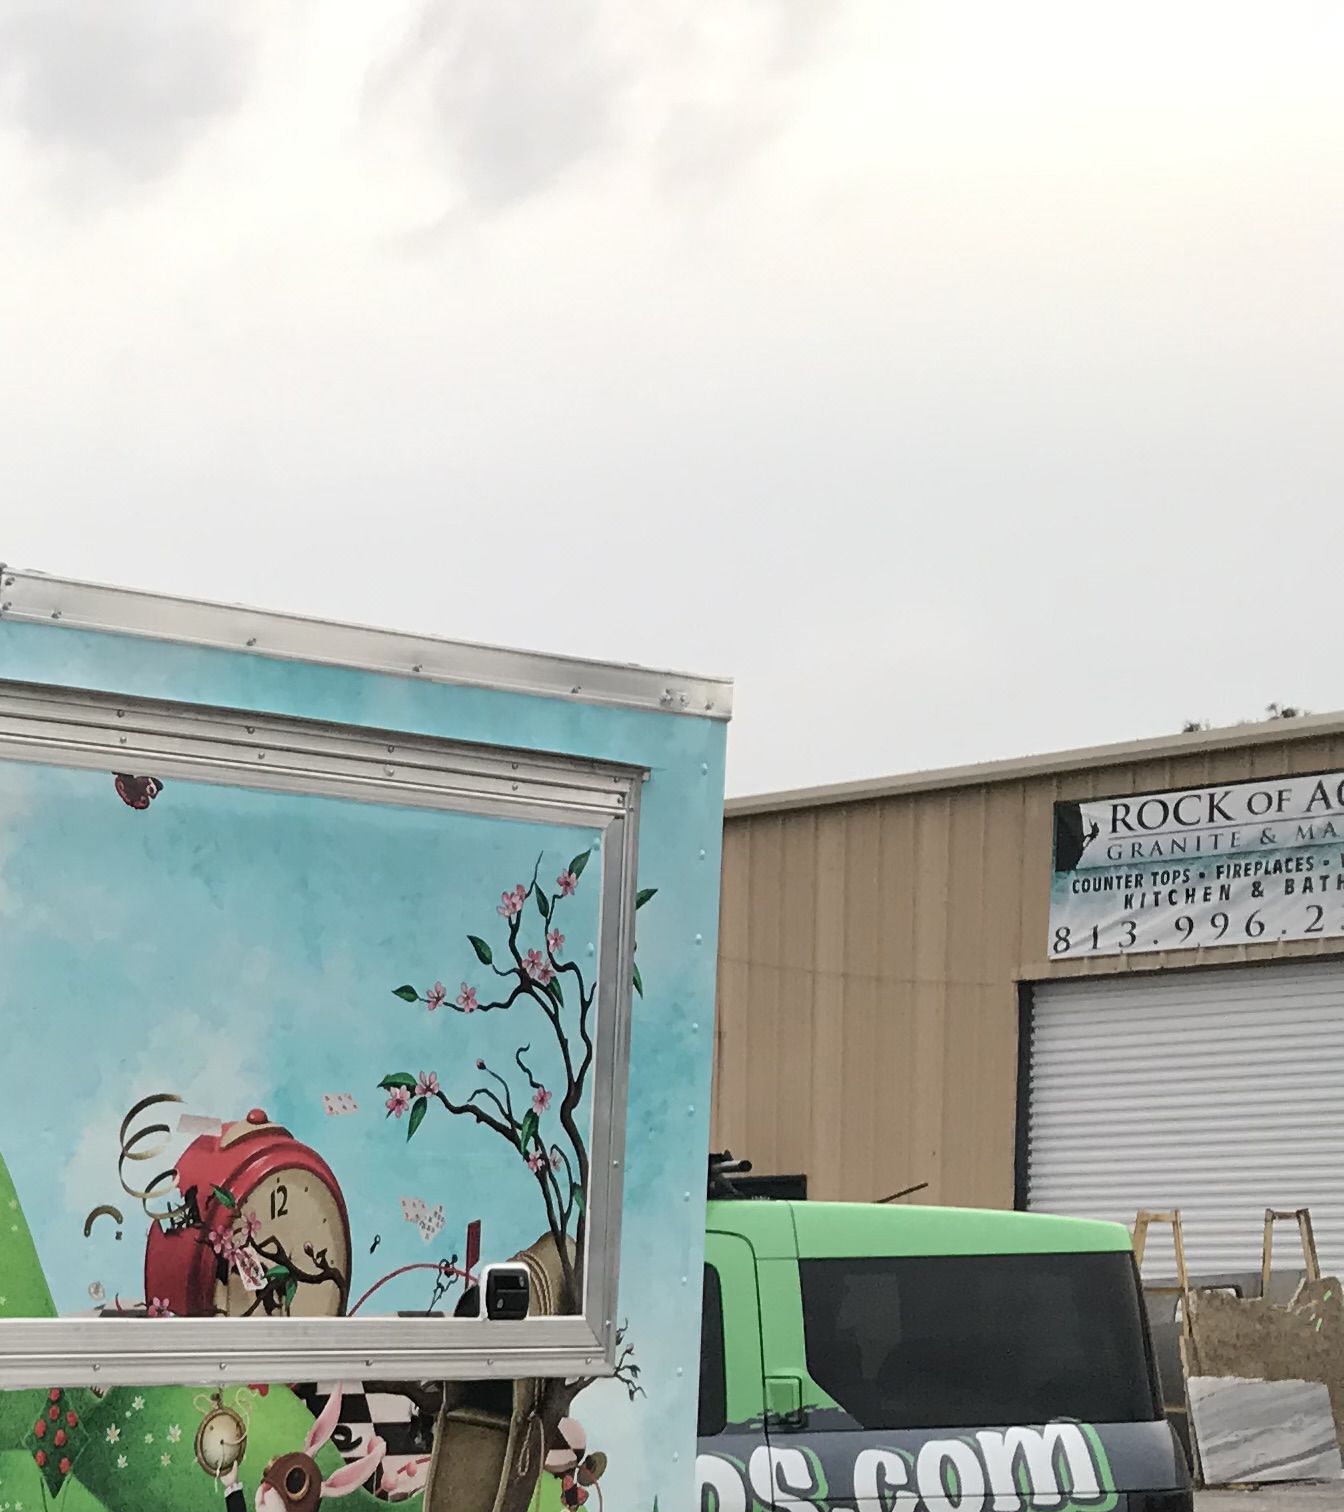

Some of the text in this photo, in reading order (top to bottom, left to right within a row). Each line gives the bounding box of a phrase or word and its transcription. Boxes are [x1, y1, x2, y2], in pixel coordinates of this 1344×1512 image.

[1109, 779, 1344, 834] ROCK OF A
[1107, 831, 1241, 861] GRANITE
[1260, 826, 1277, 846] &
[1072, 872, 1144, 895] COUNTER
[1151, 868, 1191, 887] TOPS
[1216, 855, 1315, 880] FIREPLACES
[1123, 884, 1232, 910] KITCHEN
[1251, 880, 1264, 898] &
[1053, 903, 1344, 954] 813.996.2
[270, 1184, 289, 1221] 12
